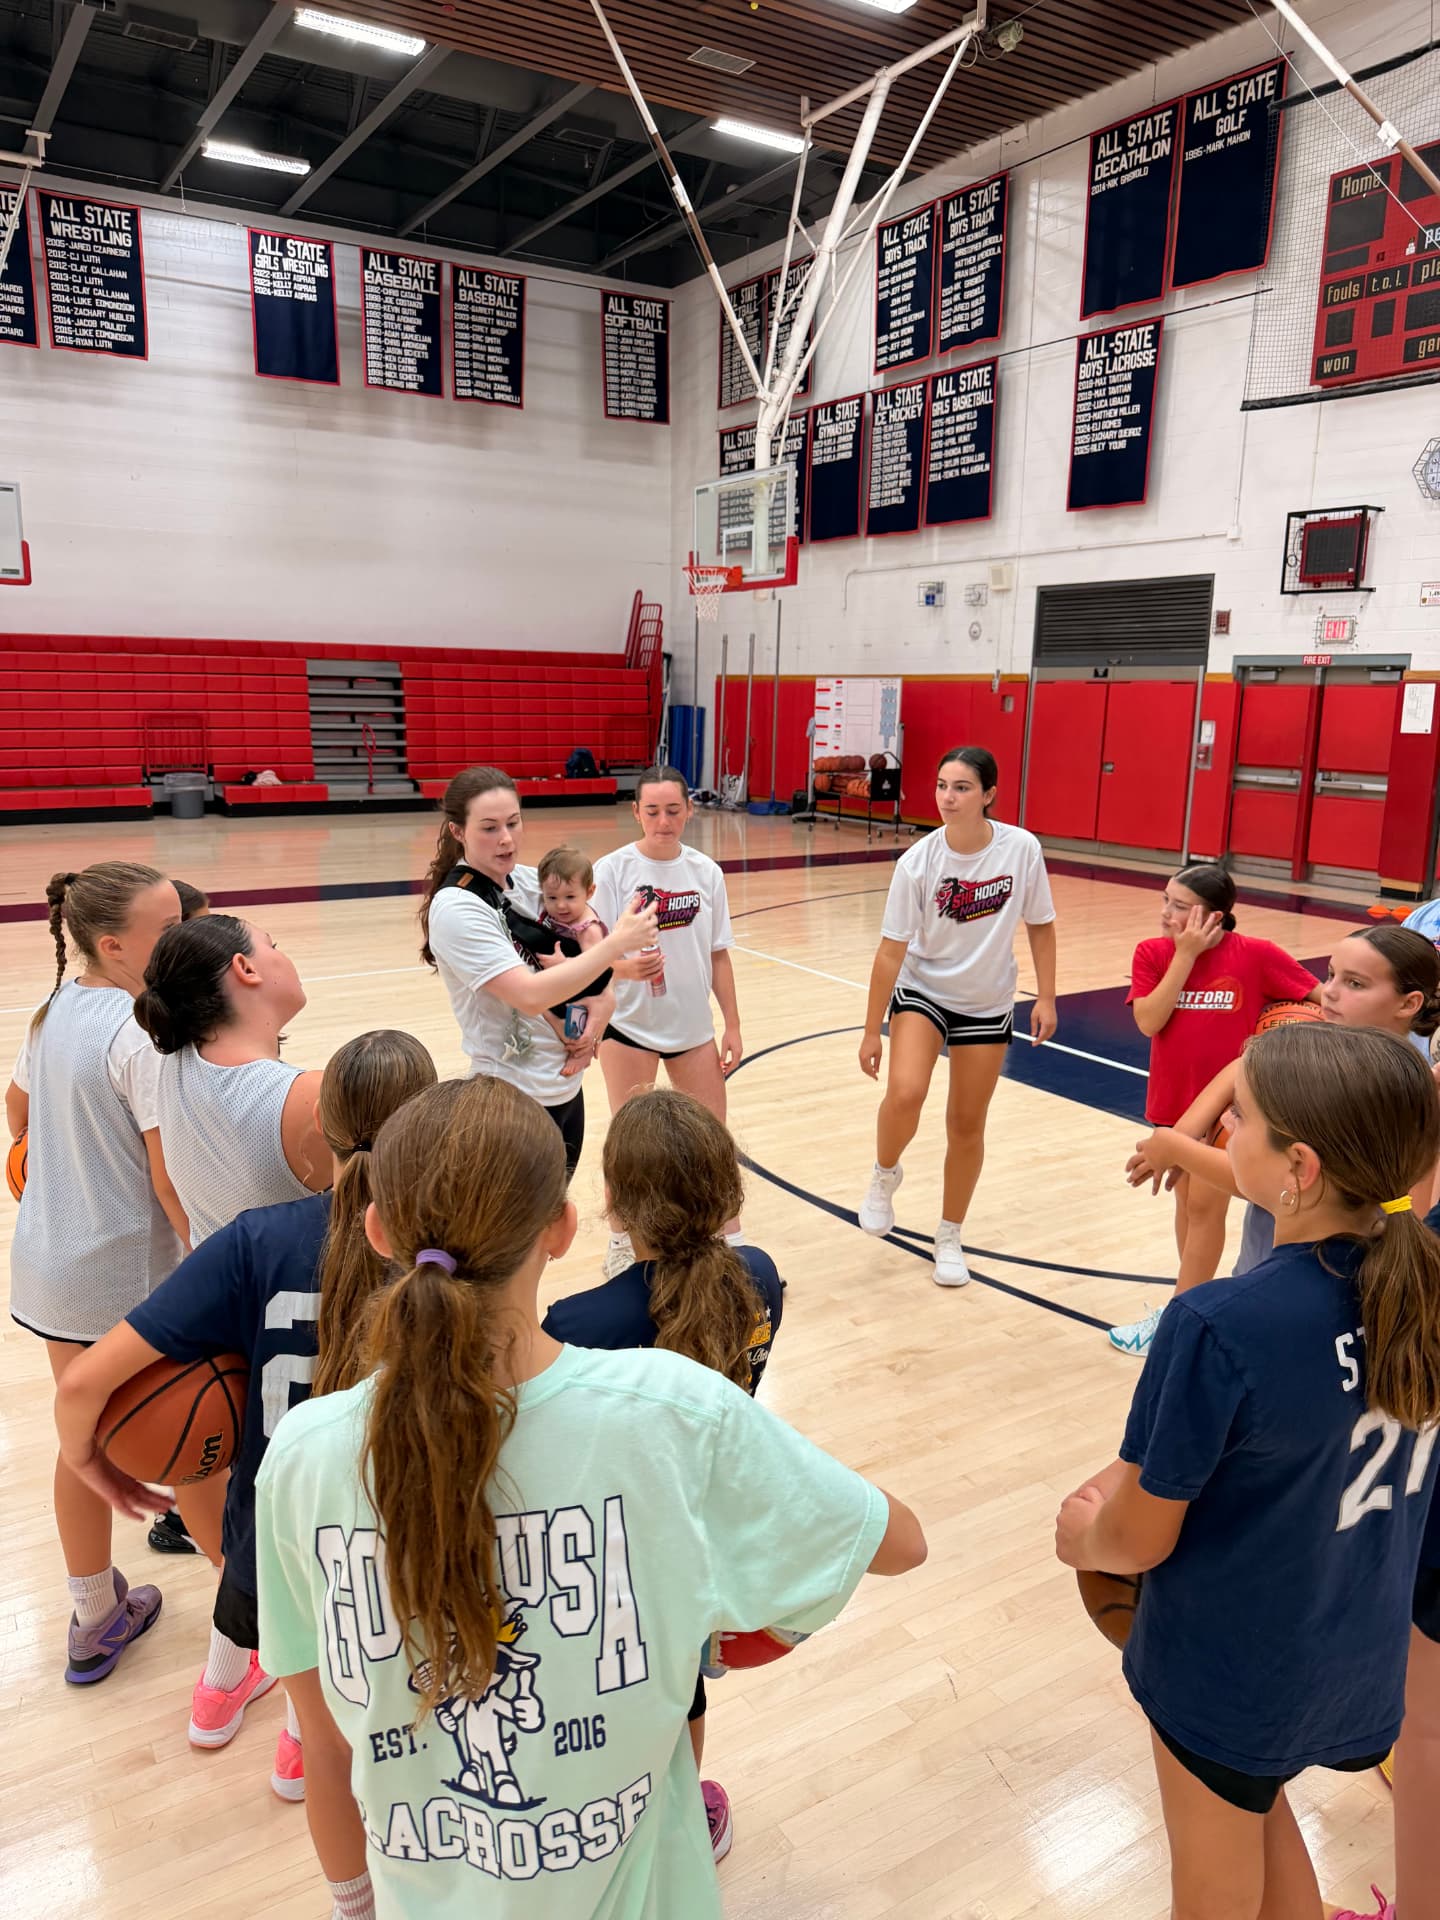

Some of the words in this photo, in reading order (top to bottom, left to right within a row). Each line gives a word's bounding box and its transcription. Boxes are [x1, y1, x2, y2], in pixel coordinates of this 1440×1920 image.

[1193, 92, 1222, 124] ALL
[1227, 69, 1277, 110] STATE
[1098, 130, 1122, 160] ALL
[1127, 110, 1173, 147] STATE
[1216, 109, 1247, 137] GOLF
[1227, 129, 1251, 147] MAHON
[1095, 137, 1171, 181] DECATHLON
[1340, 171, 1381, 198] Home
[948, 196, 966, 222] ALL
[969, 181, 1001, 212] STATE
[50, 199, 80, 222] ALL
[84, 205, 131, 231] STATE
[950, 217, 968, 240] BOYS
[971, 206, 995, 230] TRACK
[50, 221, 132, 247] WRESTLING
[883, 226, 900, 249] ALL
[902, 209, 931, 239] STATE
[82, 254, 101, 264] LUTH
[258, 234, 283, 257] ALL
[286, 239, 325, 263] STATE
[885, 245, 902, 264] BOYS
[904, 233, 927, 256] TRACK
[91, 267, 127, 279] CALLAHAN
[255, 253, 279, 271] GIRLS
[282, 257, 329, 278] WRESTLING
[368, 252, 393, 273] ALL
[398, 258, 436, 280] STATE
[84, 276, 103, 286] LUTH
[364, 269, 439, 295] BASEBALL
[458, 270, 480, 289] ALL
[484, 274, 519, 296] STATE
[741, 283, 758, 304] STATE
[1327, 280, 1360, 304] fouls
[93, 288, 130, 301] CALLAHAN
[459, 289, 518, 310] BASEBALL
[608, 296, 629, 315] ALL
[633, 300, 664, 320] STATE
[604, 313, 667, 334] SOFTBALL
[95, 340, 112, 349] LUTH
[1079, 360, 1103, 380] BOYS
[1105, 348, 1157, 374] LACROSSE
[1323, 354, 1350, 374] won
[936, 376, 956, 399] ALL
[959, 365, 992, 393] STATE
[876, 391, 893, 412] ALL
[895, 383, 923, 408] STATE
[932, 398, 950, 417] GIRLS
[952, 388, 994, 412] BASKETBALL
[816, 406, 834, 427] ALL
[835, 398, 860, 421] STATE
[874, 411, 888, 426] ICE
[889, 402, 923, 424] HOCKEY
[818, 418, 857, 440] GYMNASTICS
[723, 433, 737, 451] ALL
[724, 446, 755, 465] GYMNASTICS
[1326, 620, 1348, 640] EXIT
[1303, 656, 1317, 665] FIRE
[1317, 656, 1331, 665] EXIT
[960, 895, 1003, 915] NATION
[1178, 991, 1235, 1004] ATFORD
[369, 1727, 428, 1763] EST.
[553, 1714, 607, 1757] 2016
